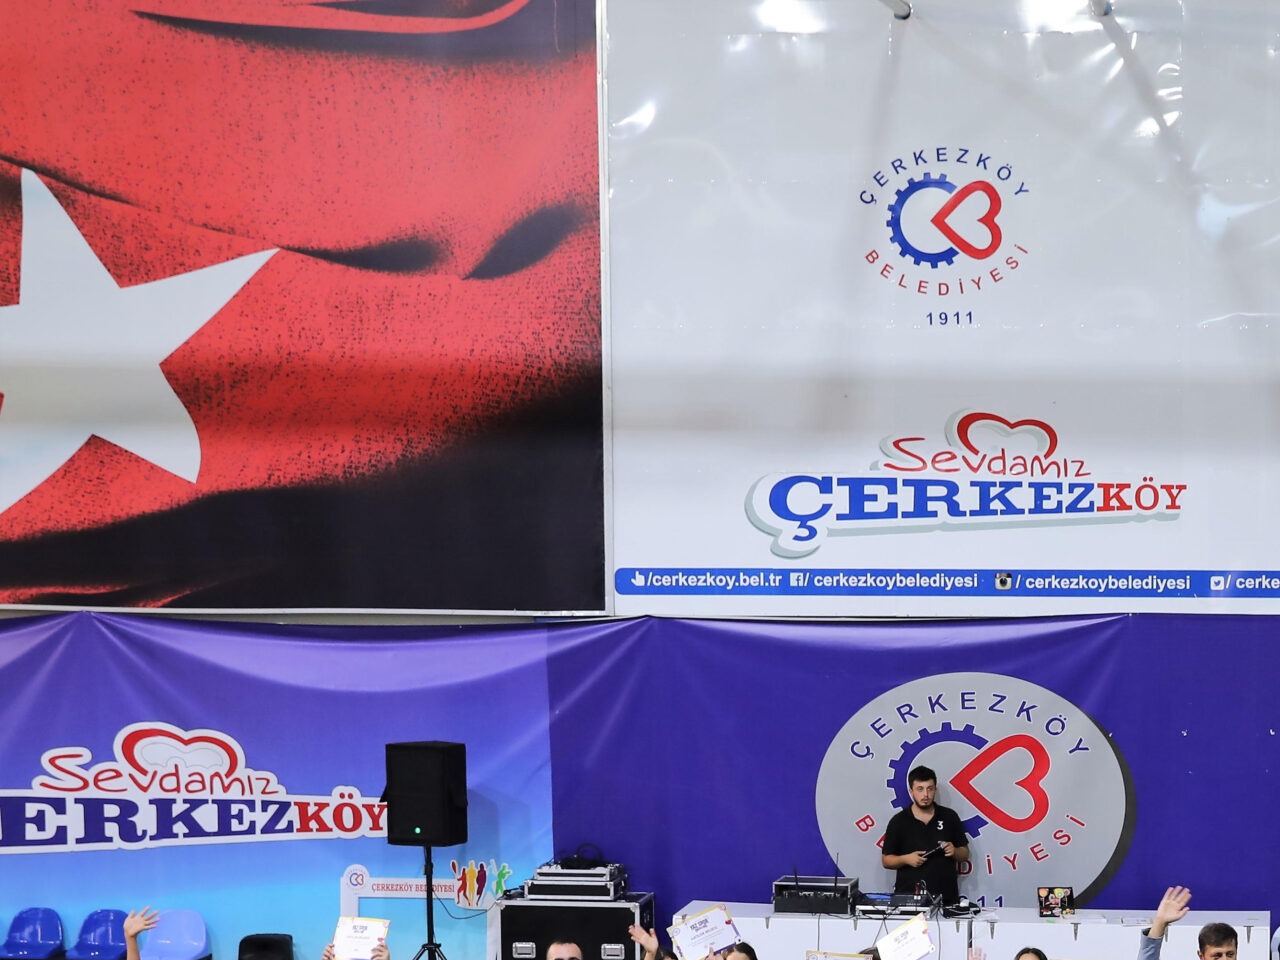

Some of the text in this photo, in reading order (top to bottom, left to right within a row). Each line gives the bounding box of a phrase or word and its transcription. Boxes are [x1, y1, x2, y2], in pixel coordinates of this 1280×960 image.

[860, 146, 1030, 206] ÇERKEZKÖY
[865, 243, 1030, 297] BELEDİYESİ
[925, 311, 975, 326] 1911
[768, 474, 1187, 542] ÇERKEZKÖY
[850, 690, 1091, 761] ÇERKEZKÖY
[0, 793, 387, 847] ERKEZKÖY
[856, 813, 1088, 876] BDİYESİ
[937, 821, 944, 830] 3
[372, 882, 454, 893] ÇERKEZKÖY BELDİYESİ
